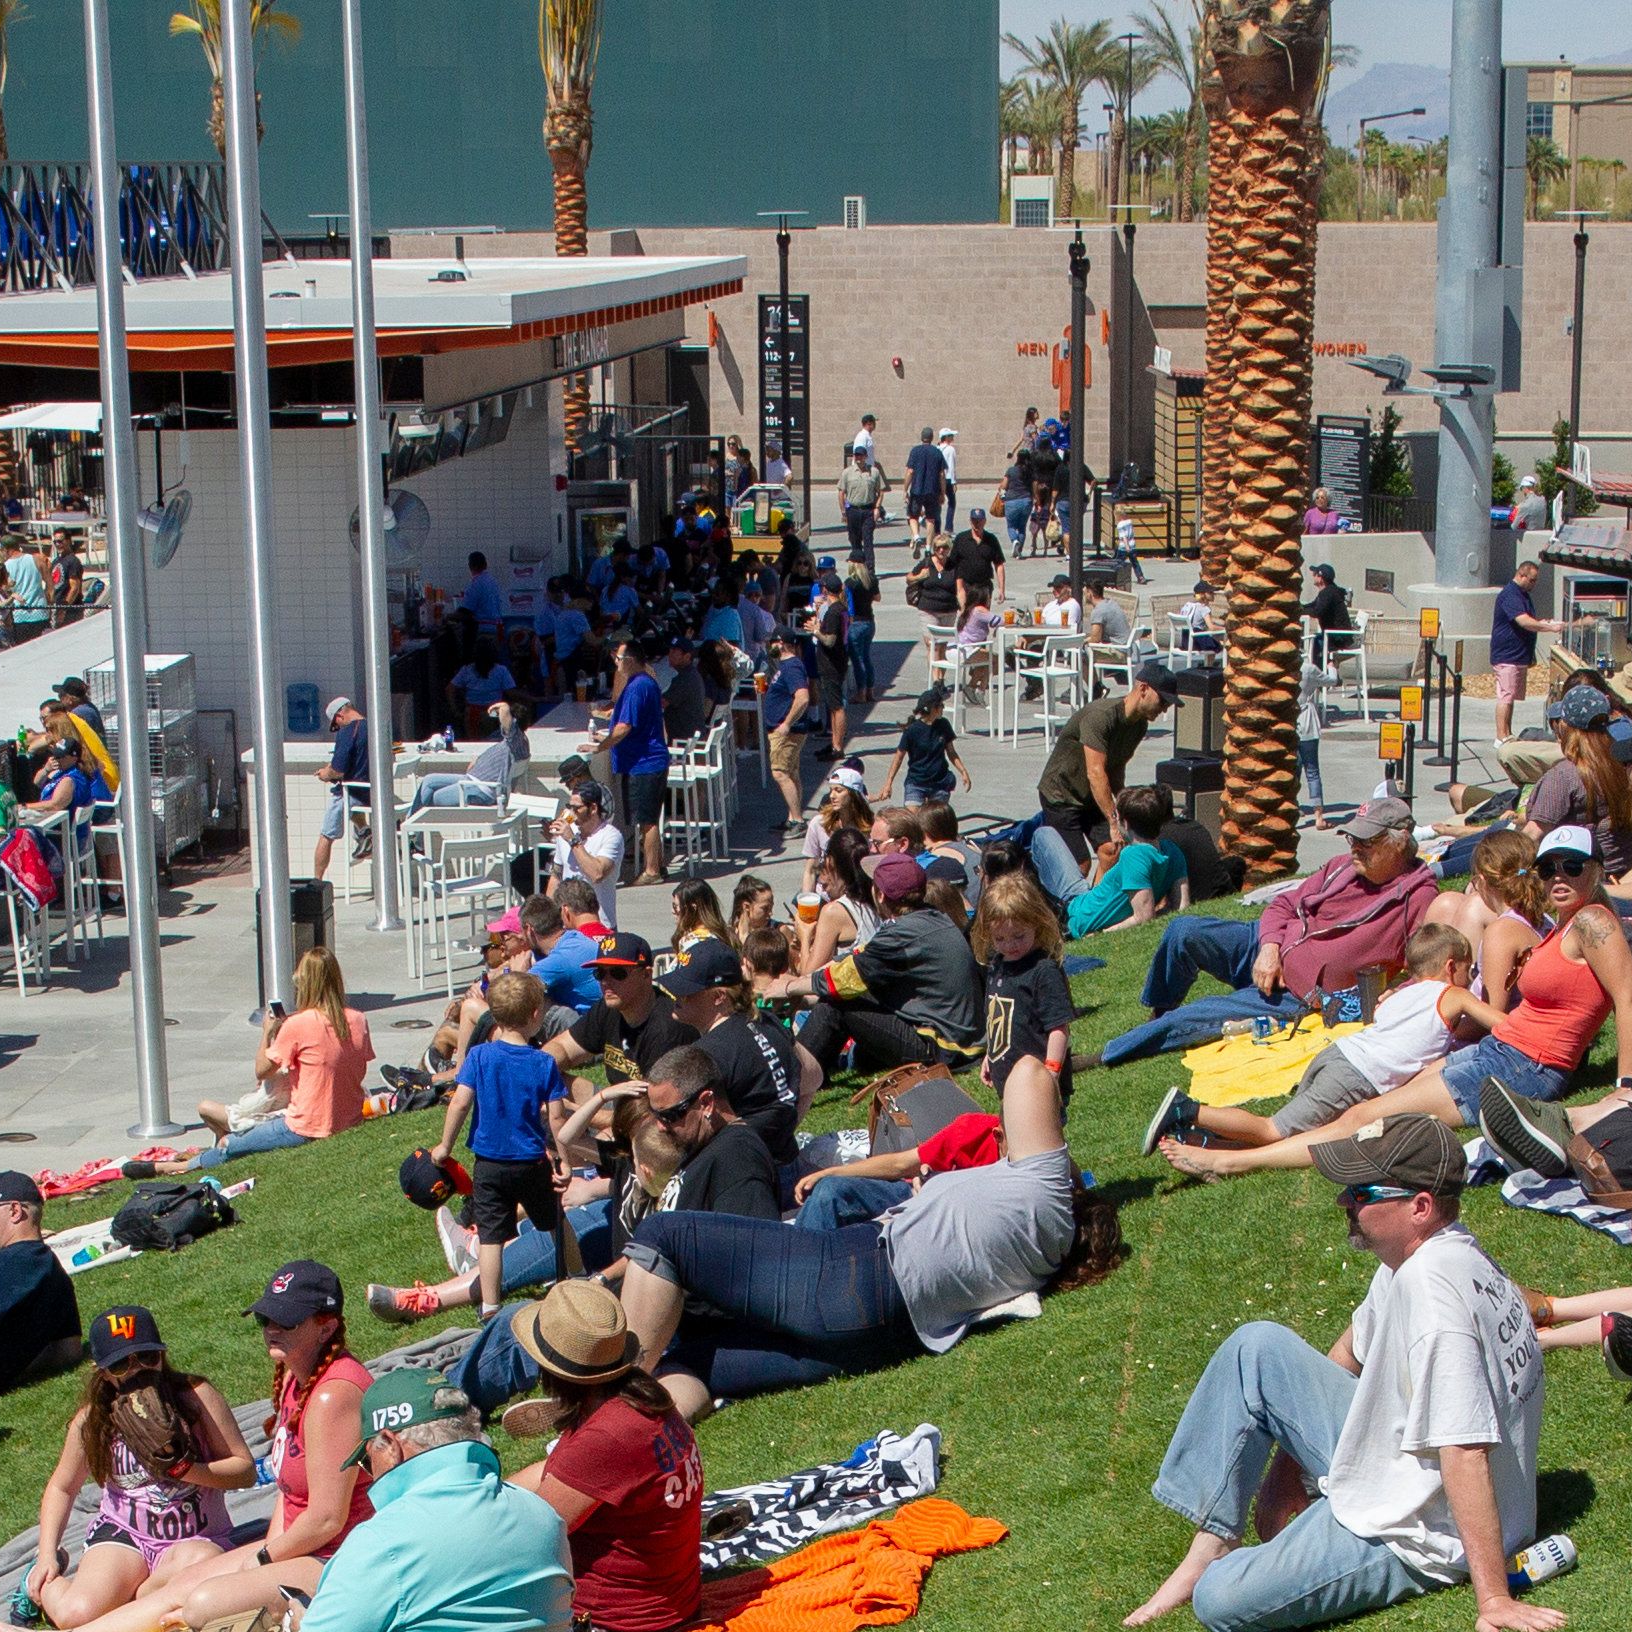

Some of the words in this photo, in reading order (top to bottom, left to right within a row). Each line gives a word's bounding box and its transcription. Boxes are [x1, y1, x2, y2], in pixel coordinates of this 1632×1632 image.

[765, 352, 795, 361] 112-7
[1017, 342, 1048, 356] MEN
[1313, 342, 1368, 356] WOMEN
[765, 416, 795, 426] 101-1
[107, 1314, 136, 1340] LV
[372, 1402, 413, 1431] 1759
[147, 1495, 208, 1540] ROLL
[1533, 1545, 1546, 1562] xtra
[1544, 1538, 1567, 1570] rona
